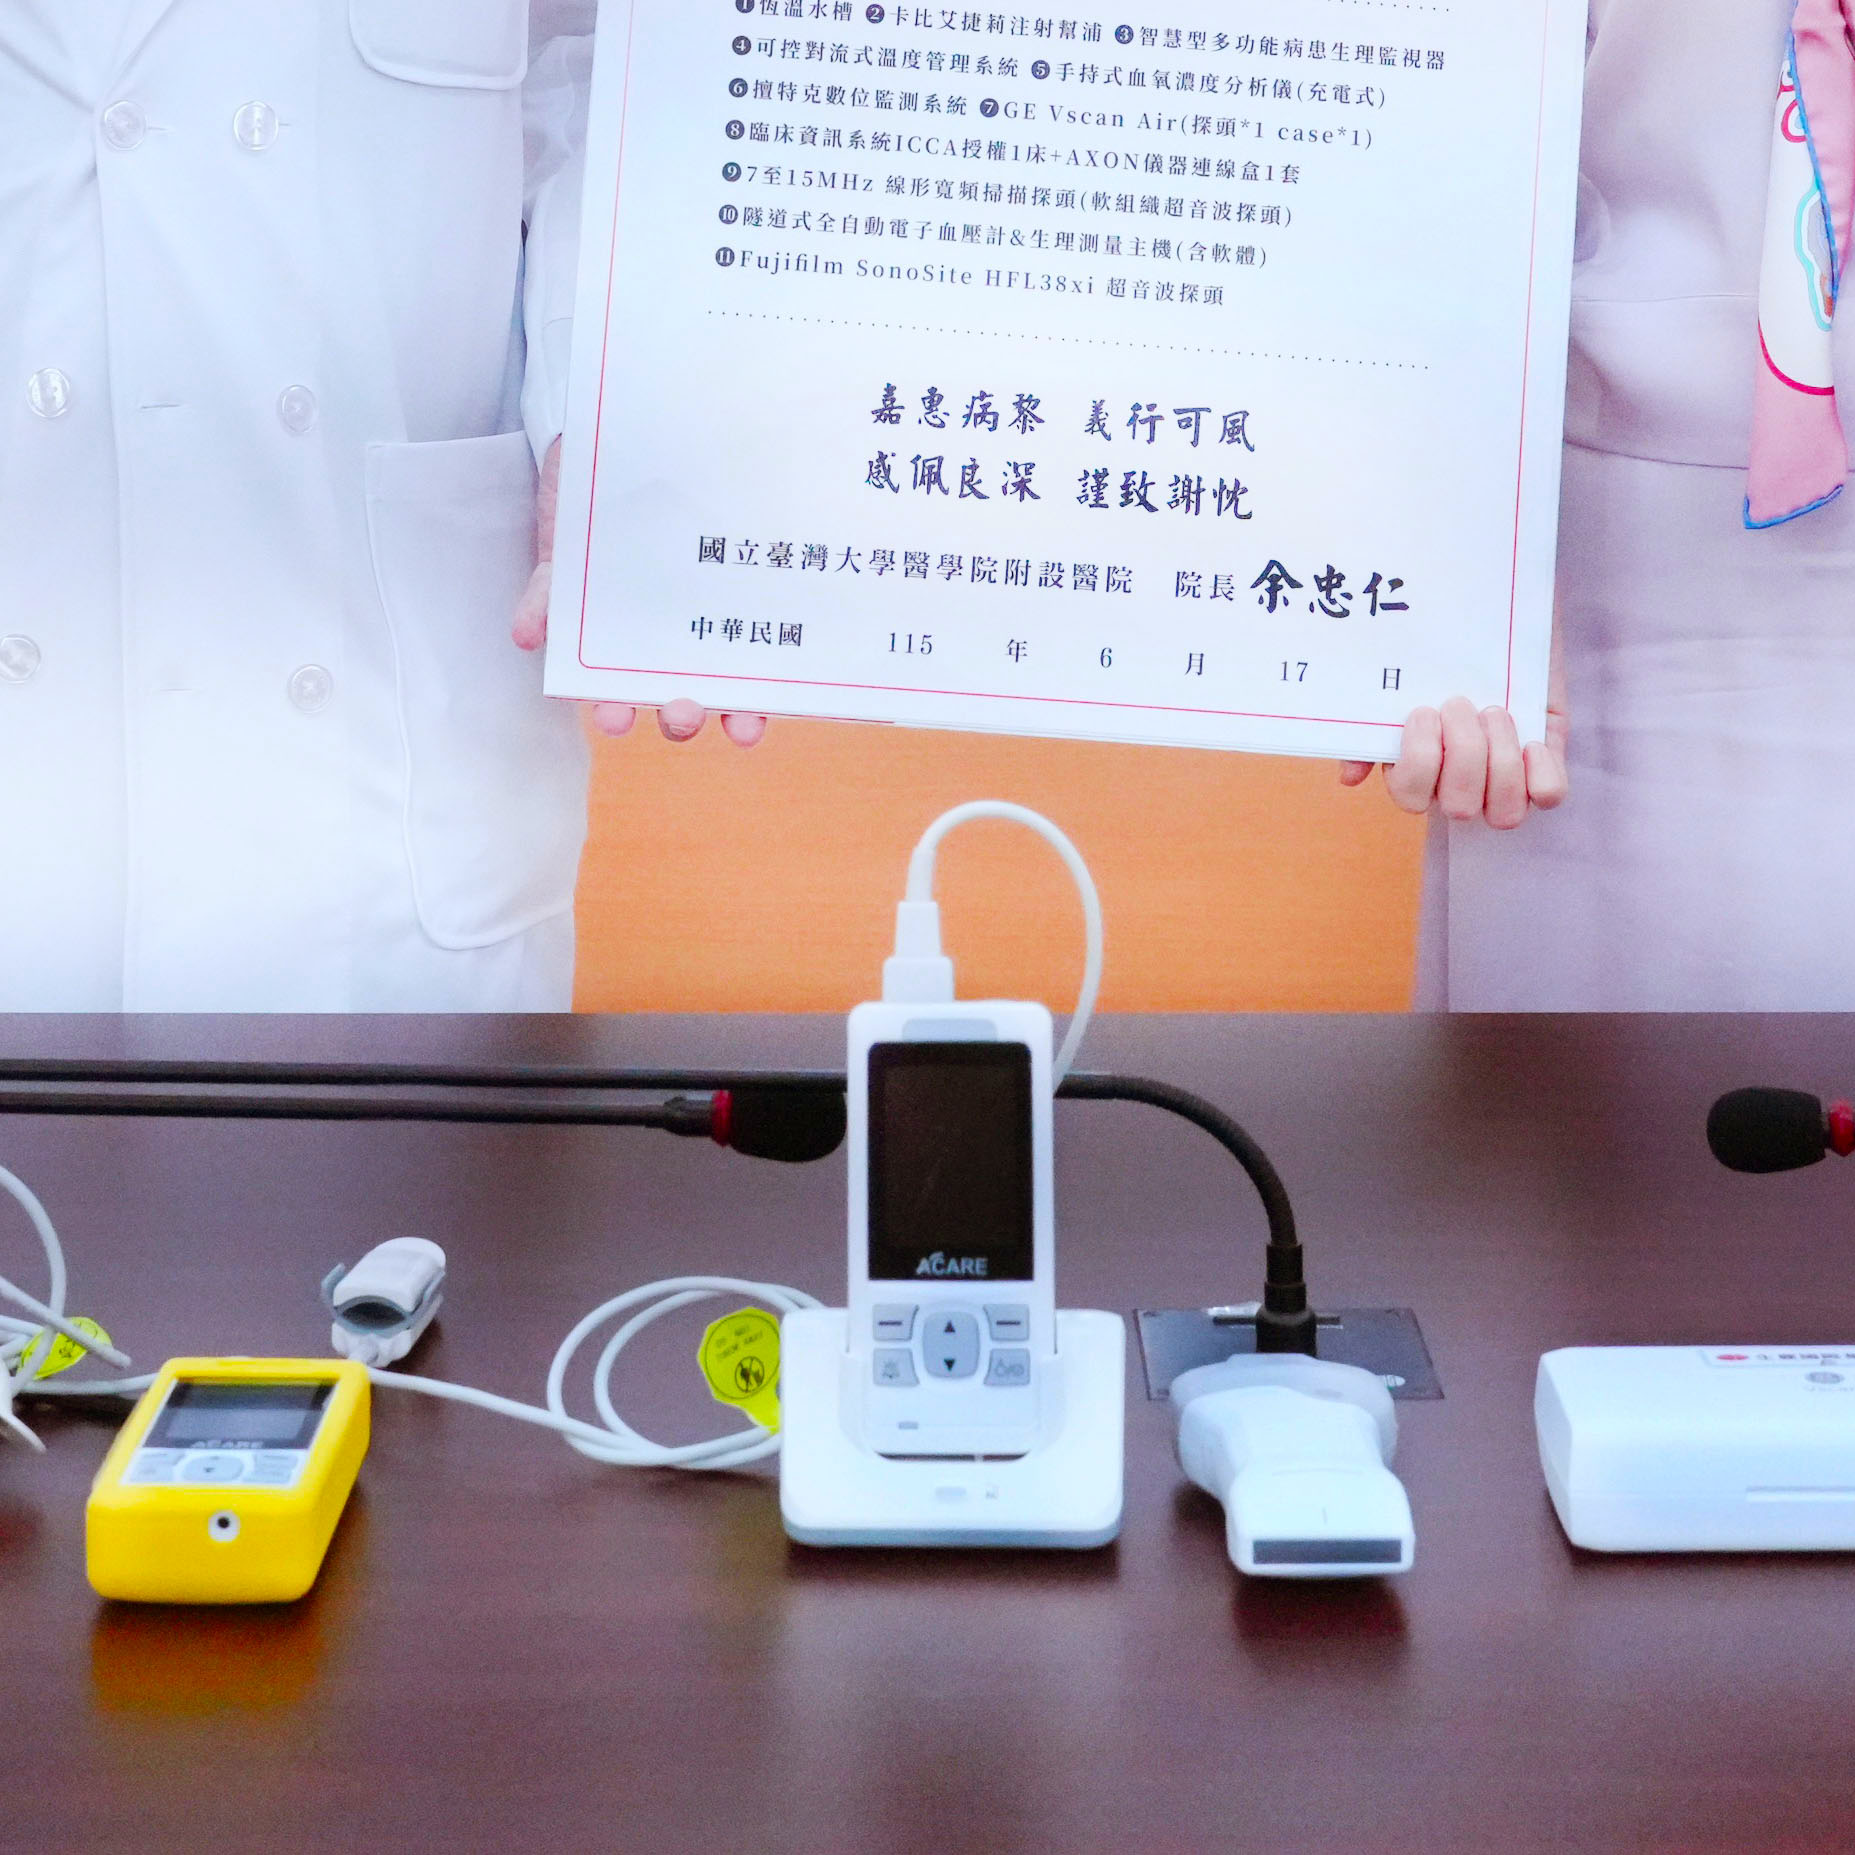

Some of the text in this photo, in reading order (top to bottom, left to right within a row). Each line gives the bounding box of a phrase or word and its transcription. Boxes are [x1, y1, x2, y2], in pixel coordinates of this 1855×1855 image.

[1048, 105, 1124, 128] Vscan
[740, 250, 844, 275] Fujifilm
[856, 259, 973, 286] SonoSite
[985, 269, 1094, 294] HFL38xi
[1106, 276, 1224, 306] 超音波探頭
[870, 383, 1255, 452] 嘉惠病黎 義行可風
[864, 450, 1253, 520] 感佩良深 謹致謝忱
[698, 535, 1410, 619] 國立臺灣大學醫學院附設醫院 院長 余忠仁
[691, 616, 1402, 691] 中華民國 115 年 6 月 17 日
[916, 1251, 989, 1276] ACARE
